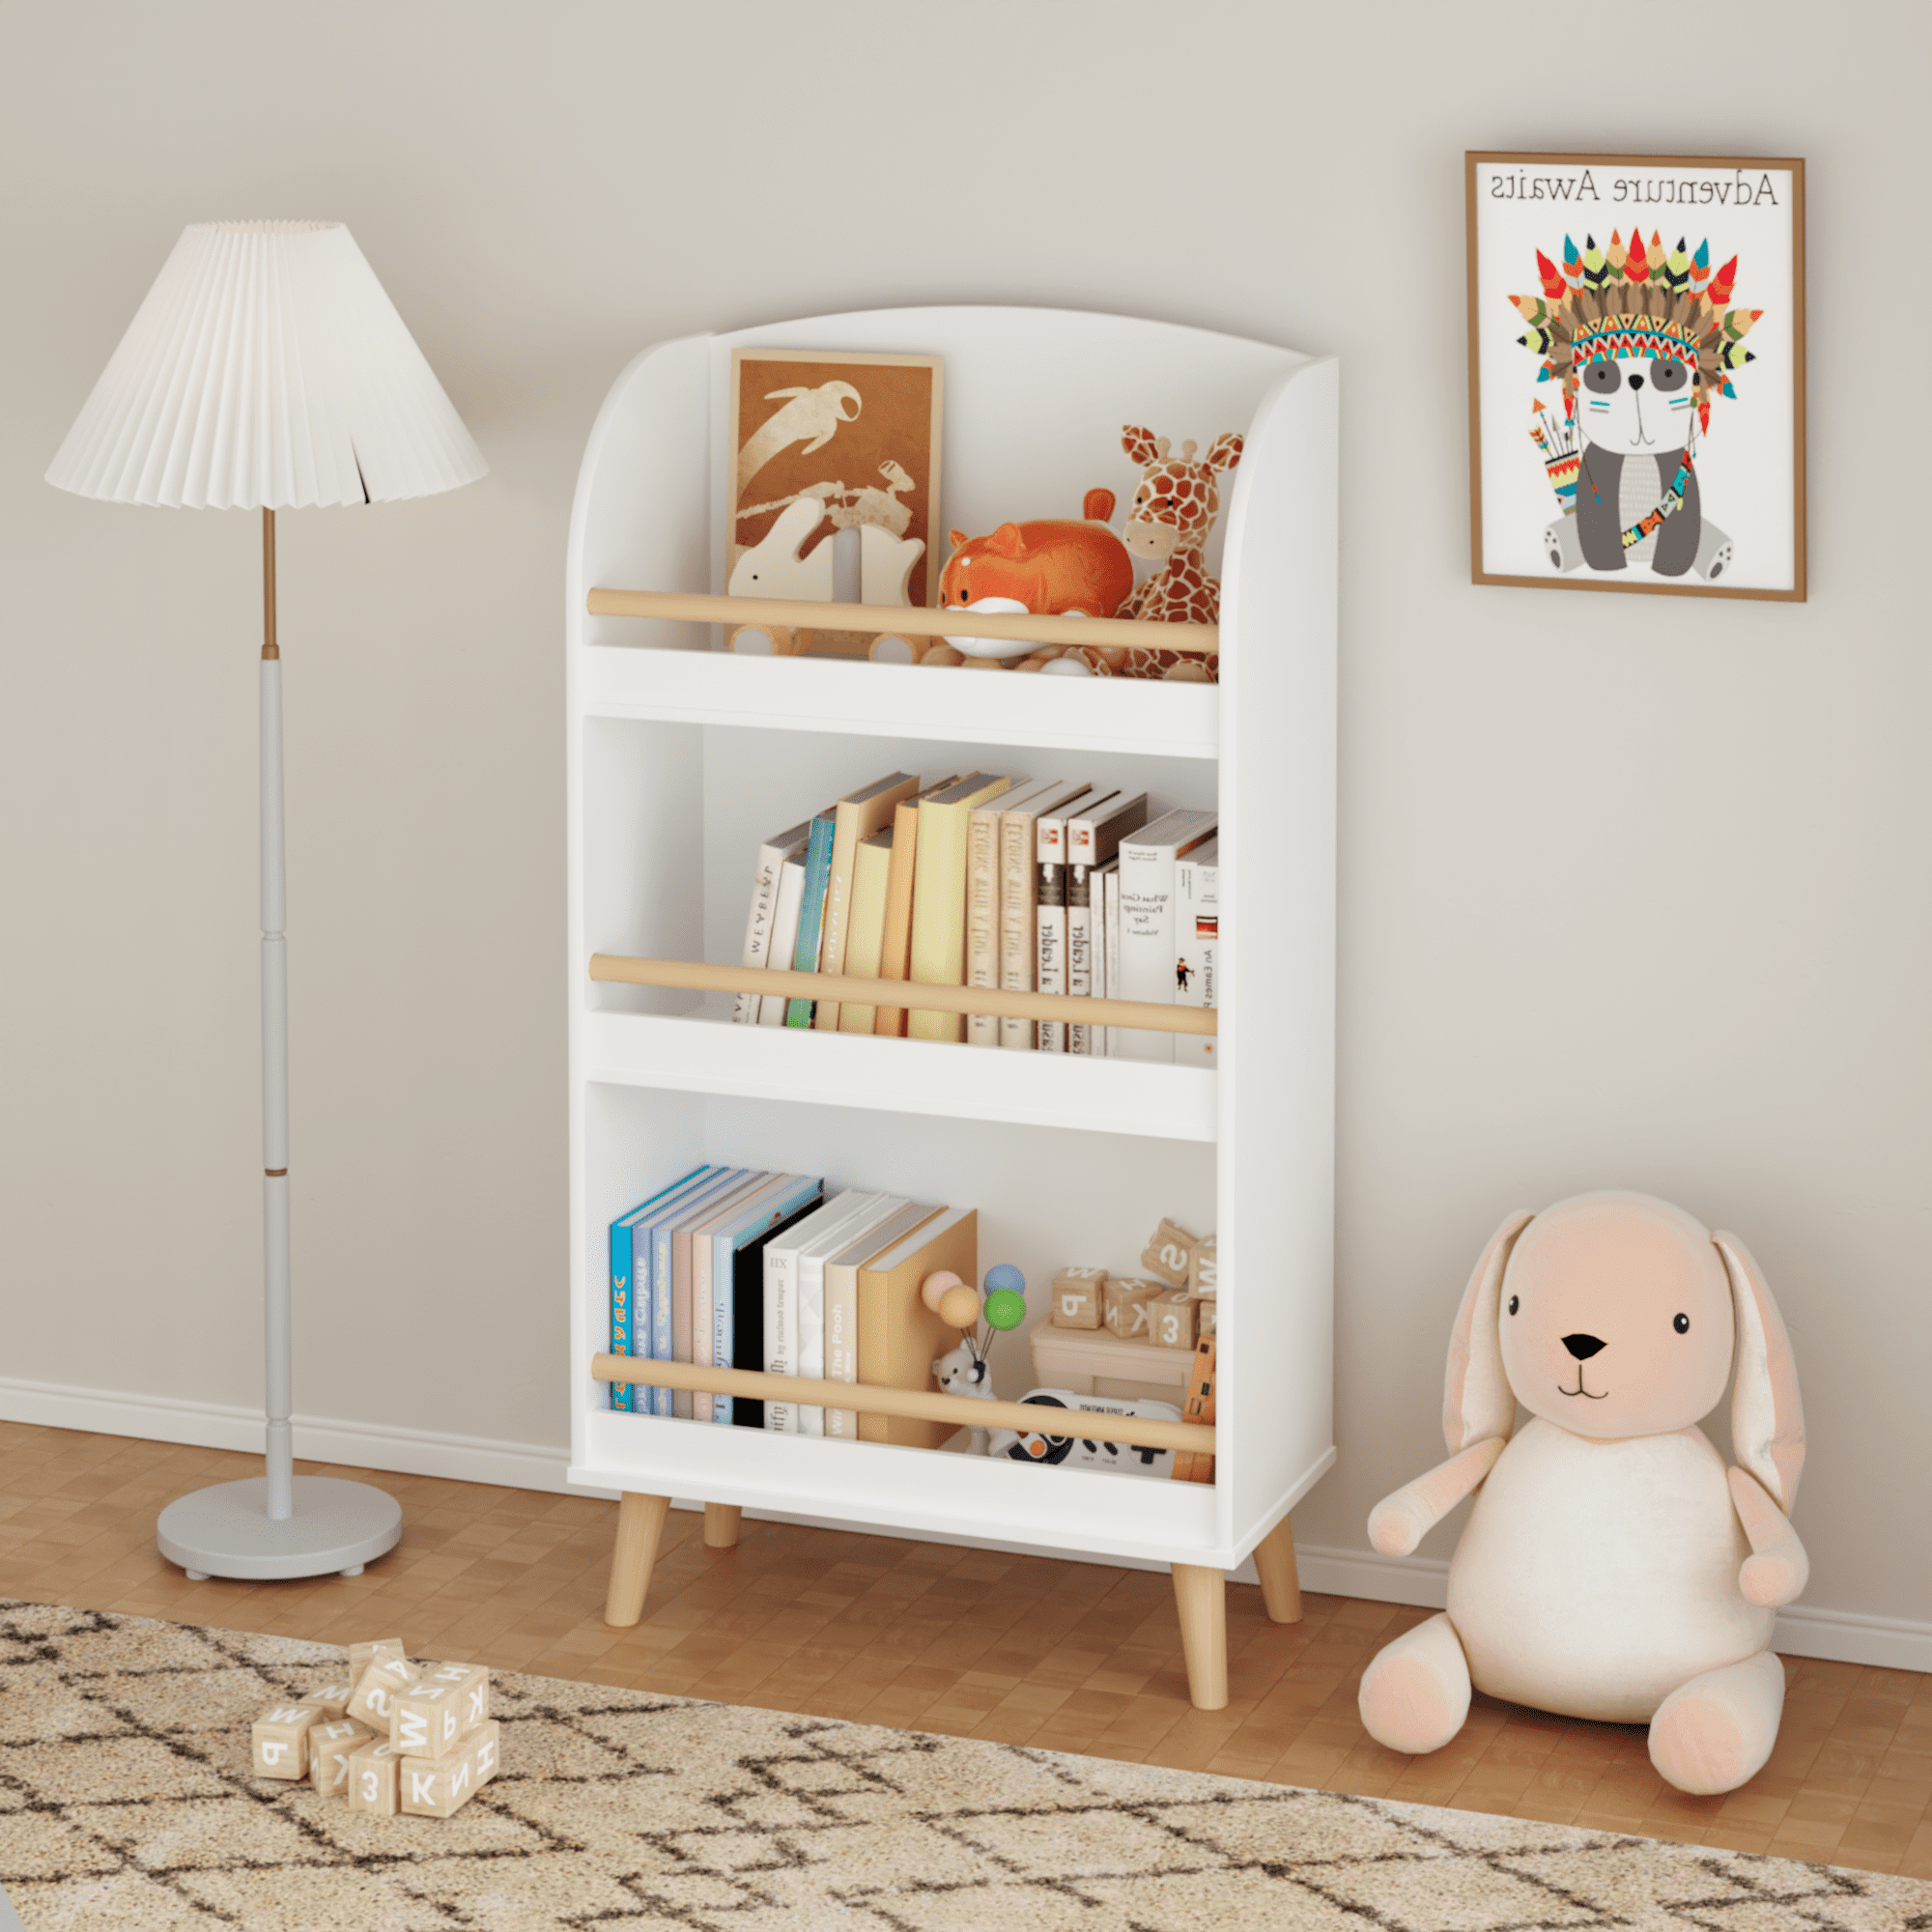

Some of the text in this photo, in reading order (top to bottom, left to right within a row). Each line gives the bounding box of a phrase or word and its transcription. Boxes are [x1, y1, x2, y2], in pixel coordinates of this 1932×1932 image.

[831, 1303, 843, 1345] Pooh
[831, 1349, 843, 1376] The
[412, 1772, 437, 1806] K
